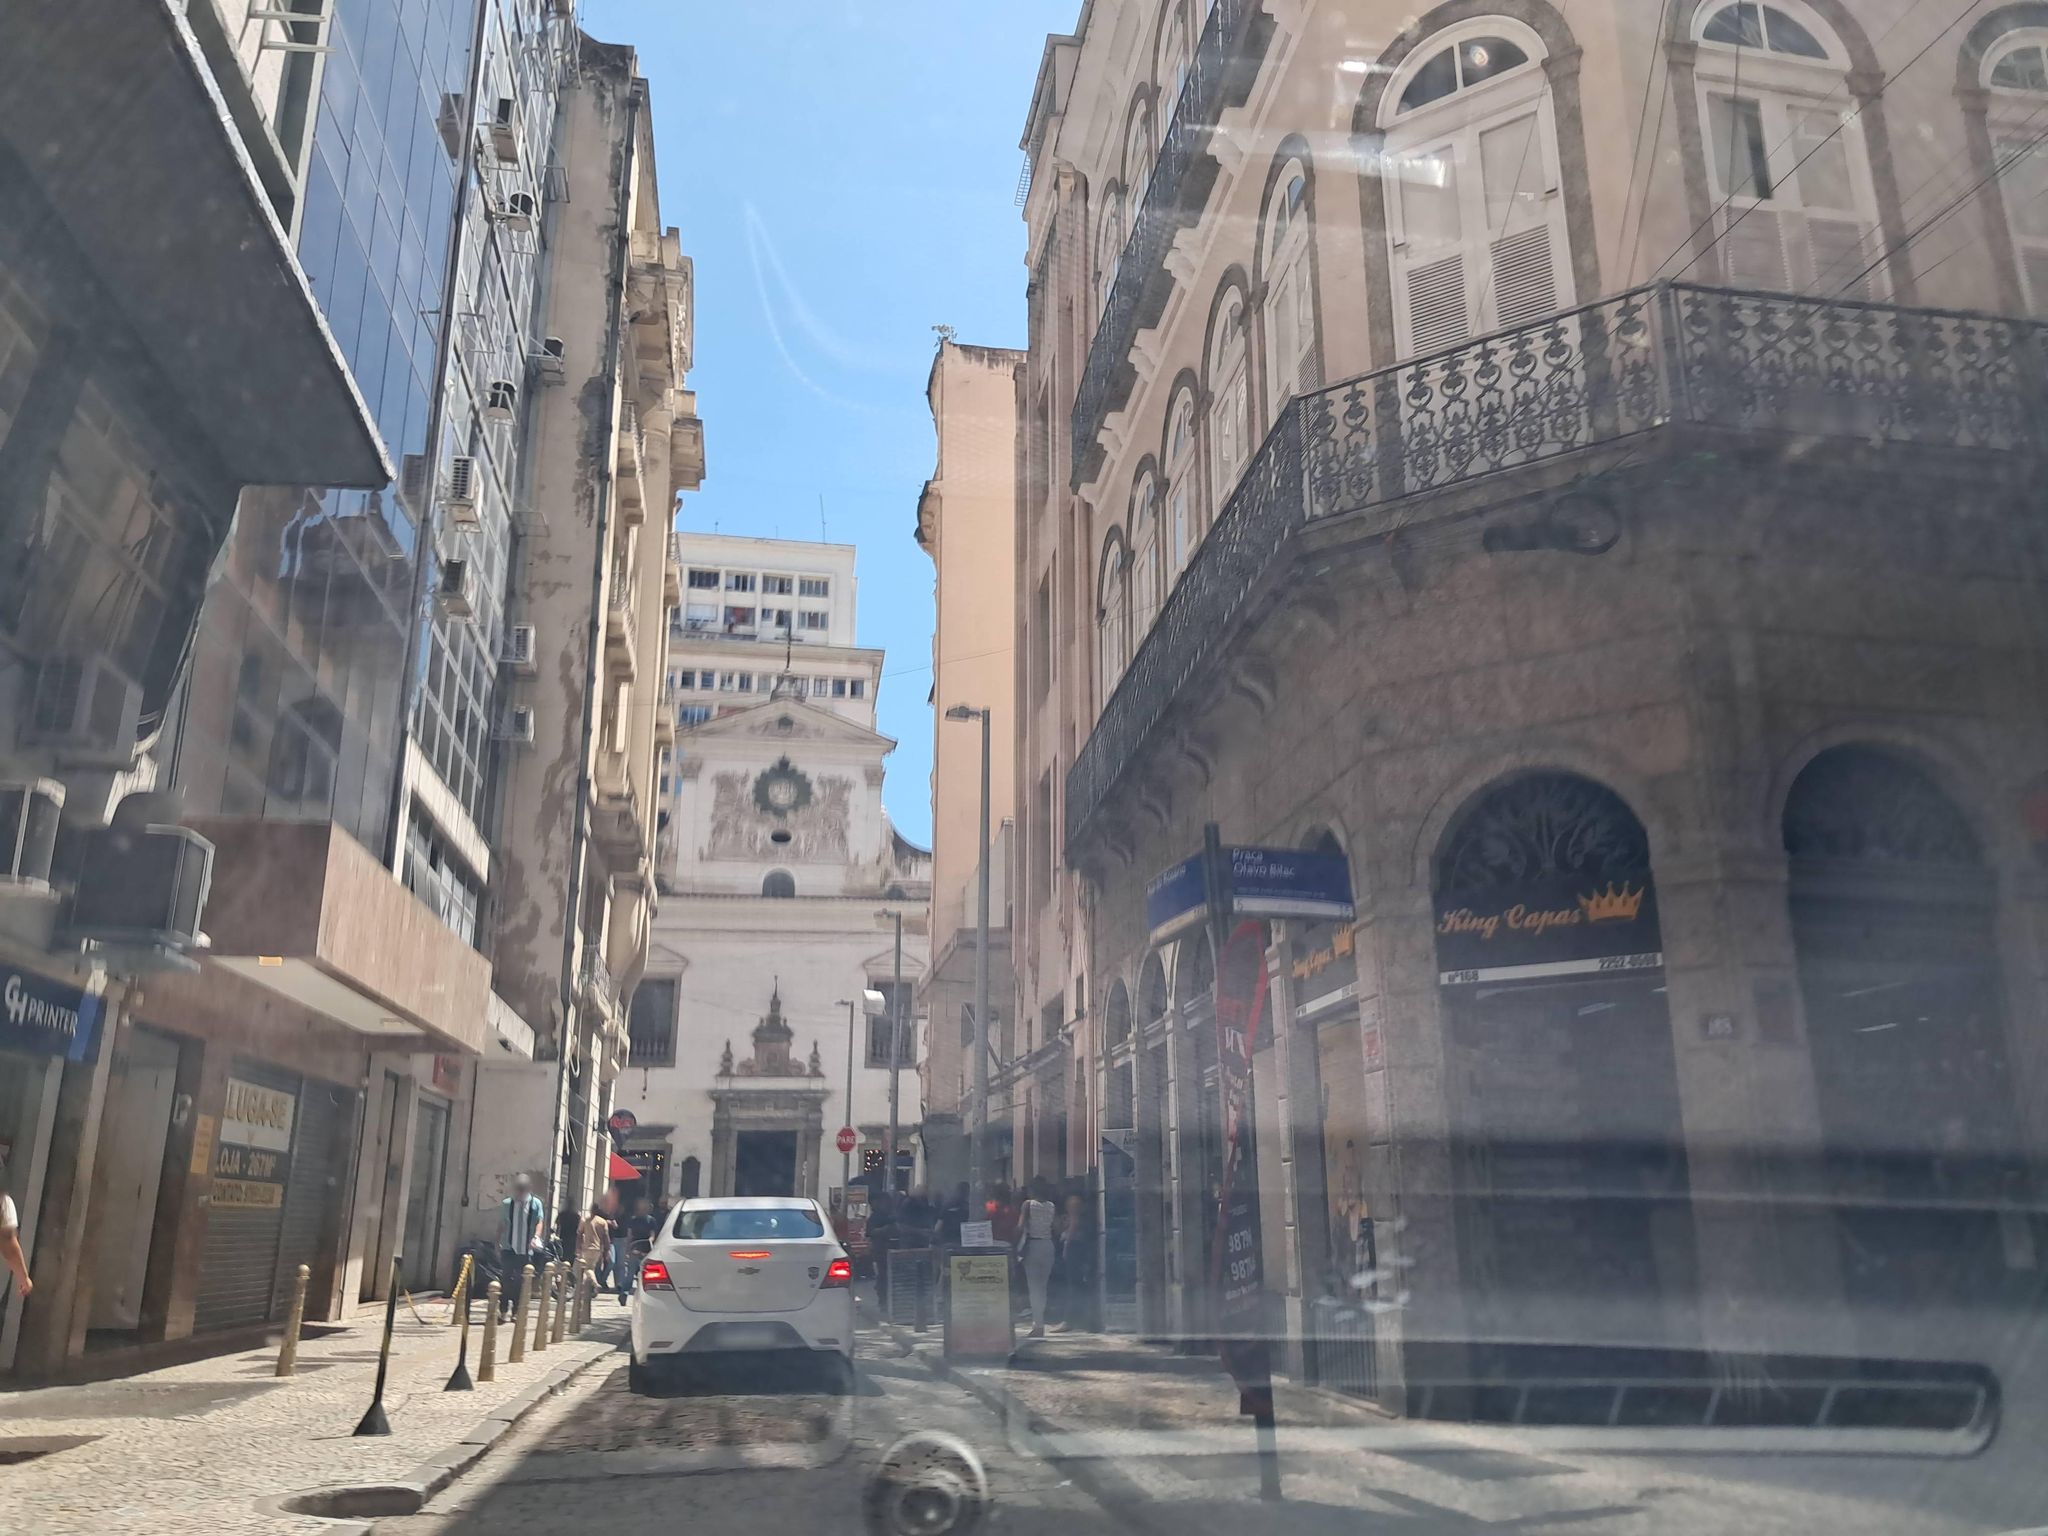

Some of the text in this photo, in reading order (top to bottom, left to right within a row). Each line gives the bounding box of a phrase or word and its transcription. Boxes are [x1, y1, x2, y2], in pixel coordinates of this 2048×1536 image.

[1232, 862, 1297, 877] Olavo Bilac
[1437, 903, 1583, 939] King Capas
[28, 998, 78, 1038] PRINTER
[224, 1083, 289, 1131] LUGA-SE
[837, 1136, 855, 1145] PARE
[216, 1146, 241, 1175] OJA
